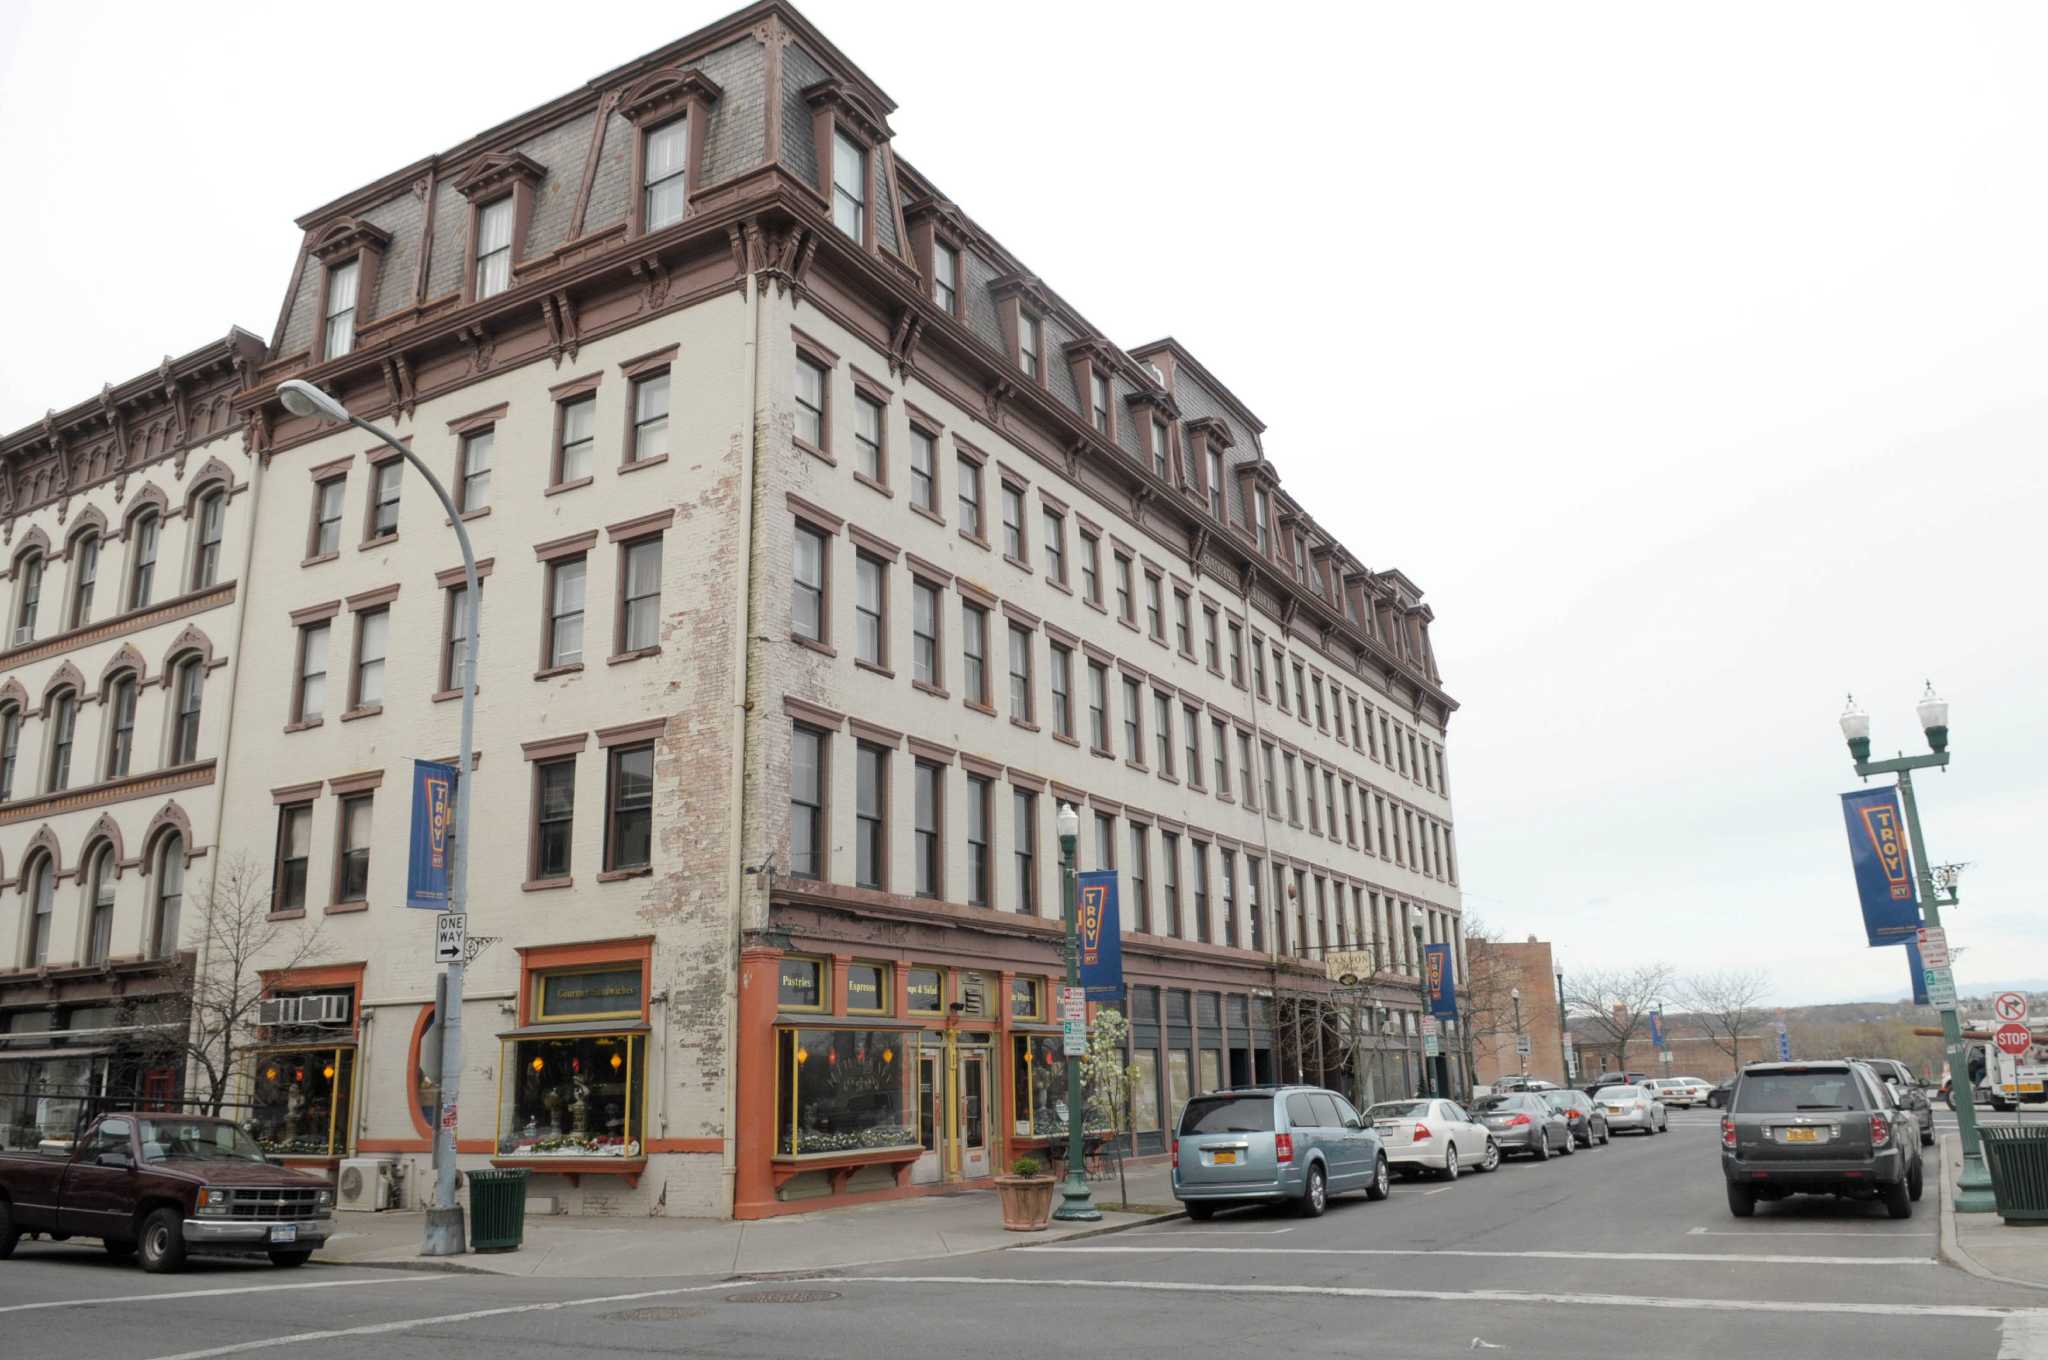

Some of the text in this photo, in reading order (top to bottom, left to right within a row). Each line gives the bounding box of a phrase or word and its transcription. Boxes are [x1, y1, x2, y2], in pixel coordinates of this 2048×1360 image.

[433, 786, 446, 841] TROY
[1877, 813, 1899, 871] TROY
[440, 917, 463, 930] ONE
[1086, 893, 1096, 941] TROY
[440, 929, 463, 943] WAY
[782, 975, 812, 988] Pastries
[848, 980, 876, 992] Espresso
[1926, 973, 1936, 985] 2
[1999, 1032, 2028, 1046] STOP
